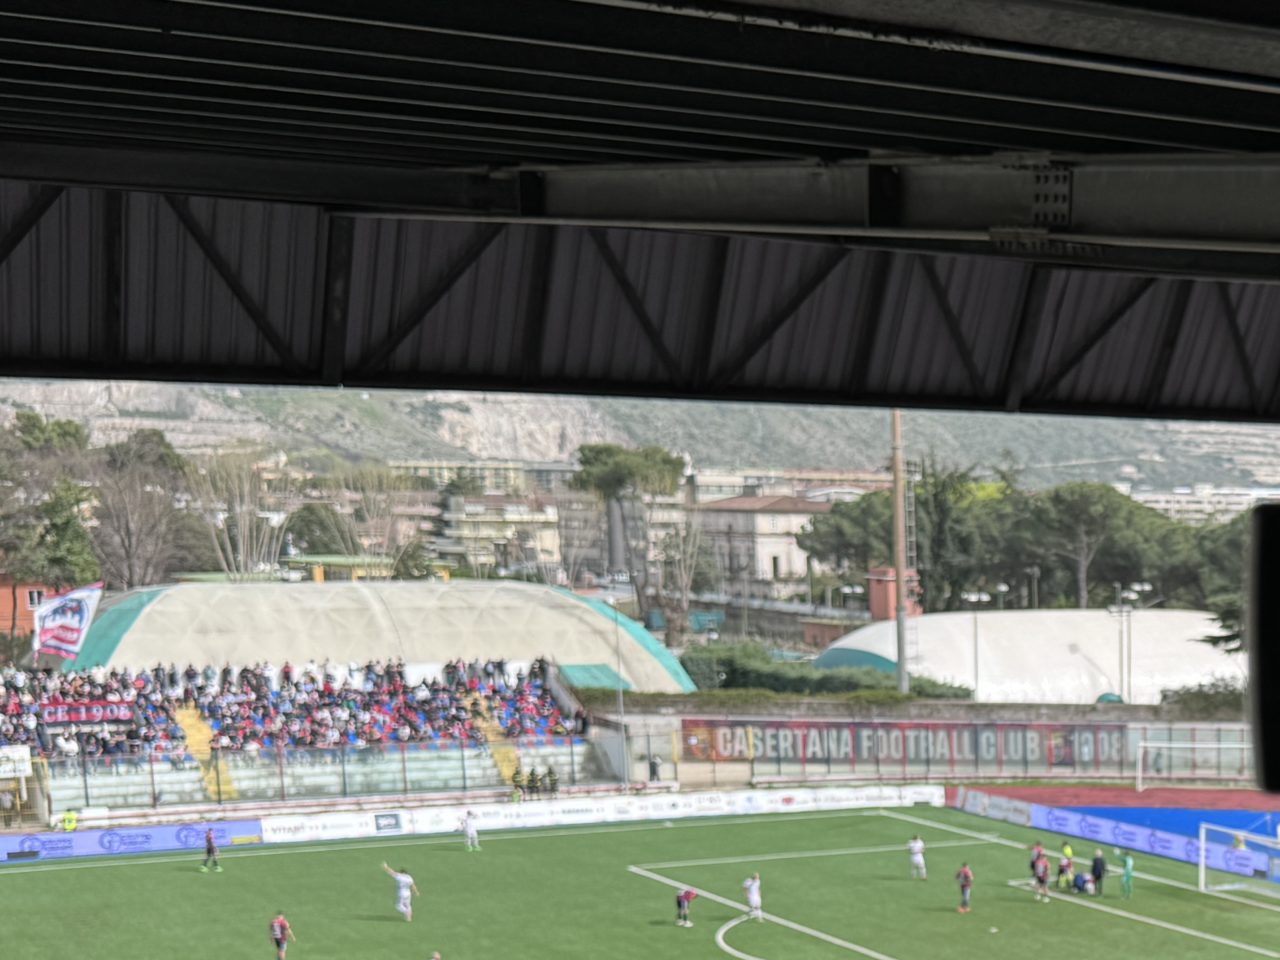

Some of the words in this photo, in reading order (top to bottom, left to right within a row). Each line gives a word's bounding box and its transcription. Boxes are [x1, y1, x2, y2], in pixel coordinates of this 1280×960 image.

[717, 725, 854, 759] CASERTANA
[861, 727, 976, 760] FOOTBALL
[980, 729, 1041, 761] CLUB
